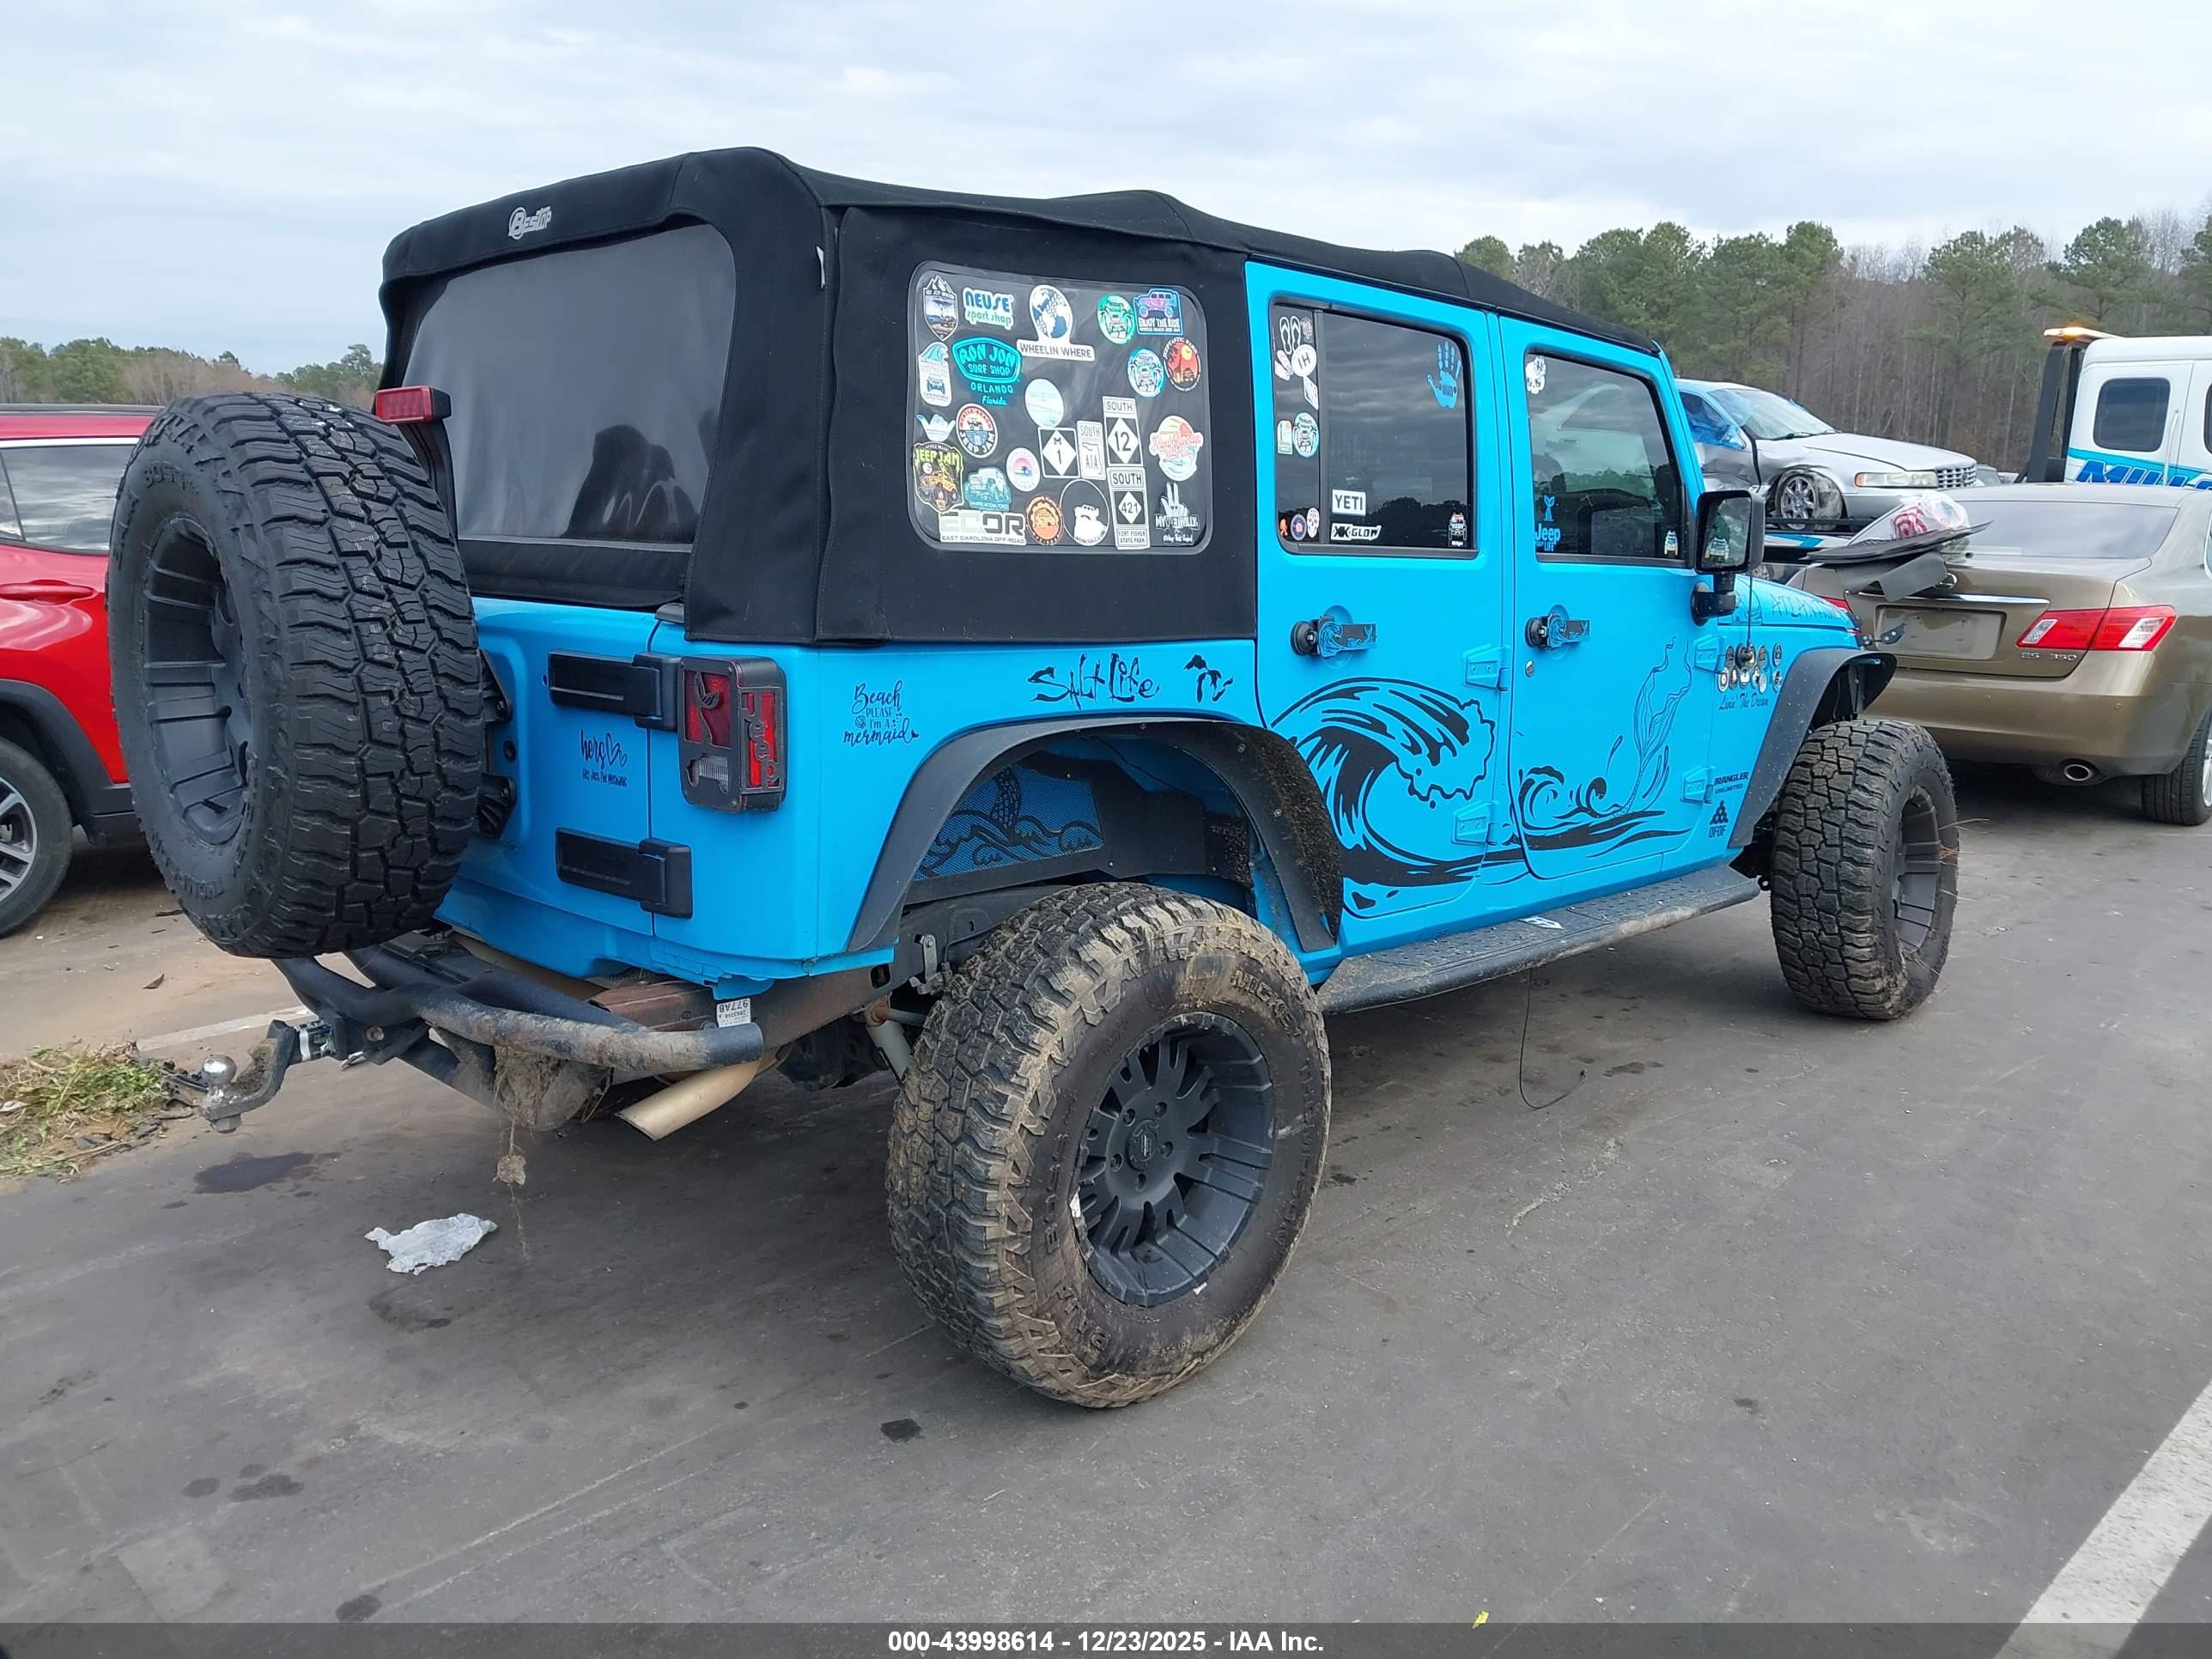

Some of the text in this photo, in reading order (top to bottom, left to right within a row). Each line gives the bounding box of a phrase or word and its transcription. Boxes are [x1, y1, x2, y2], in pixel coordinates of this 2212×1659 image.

[967, 310, 1012, 327] sport shop
[959, 343, 1016, 368] RON JON
[1019, 343, 1092, 358] WHEELIN WHERE
[969, 363, 1011, 376] SURF SHOP
[970, 382, 1013, 394] ORLANDO
[1106, 401, 1133, 412] SOUTH
[1080, 425, 1100, 437] SOUTH
[982, 432, 995, 453] JAM
[1054, 437, 1062, 446] M
[1114, 430, 1132, 452] 12
[915, 448, 937, 465] JEEP
[1057, 448, 1062, 465] 1
[1112, 472, 1142, 485] SOUTH
[1121, 501, 1139, 514] 421
[1334, 495, 1363, 511] YETI
[1534, 523, 1561, 545] Jeep
[1544, 541, 1554, 552] LIFE
[851, 679, 903, 714] Beach
[1739, 692, 1749, 708] The
[1750, 692, 1769, 708] Dream
[866, 707, 893, 718] PLEASE
[843, 717, 915, 747] mermaid
